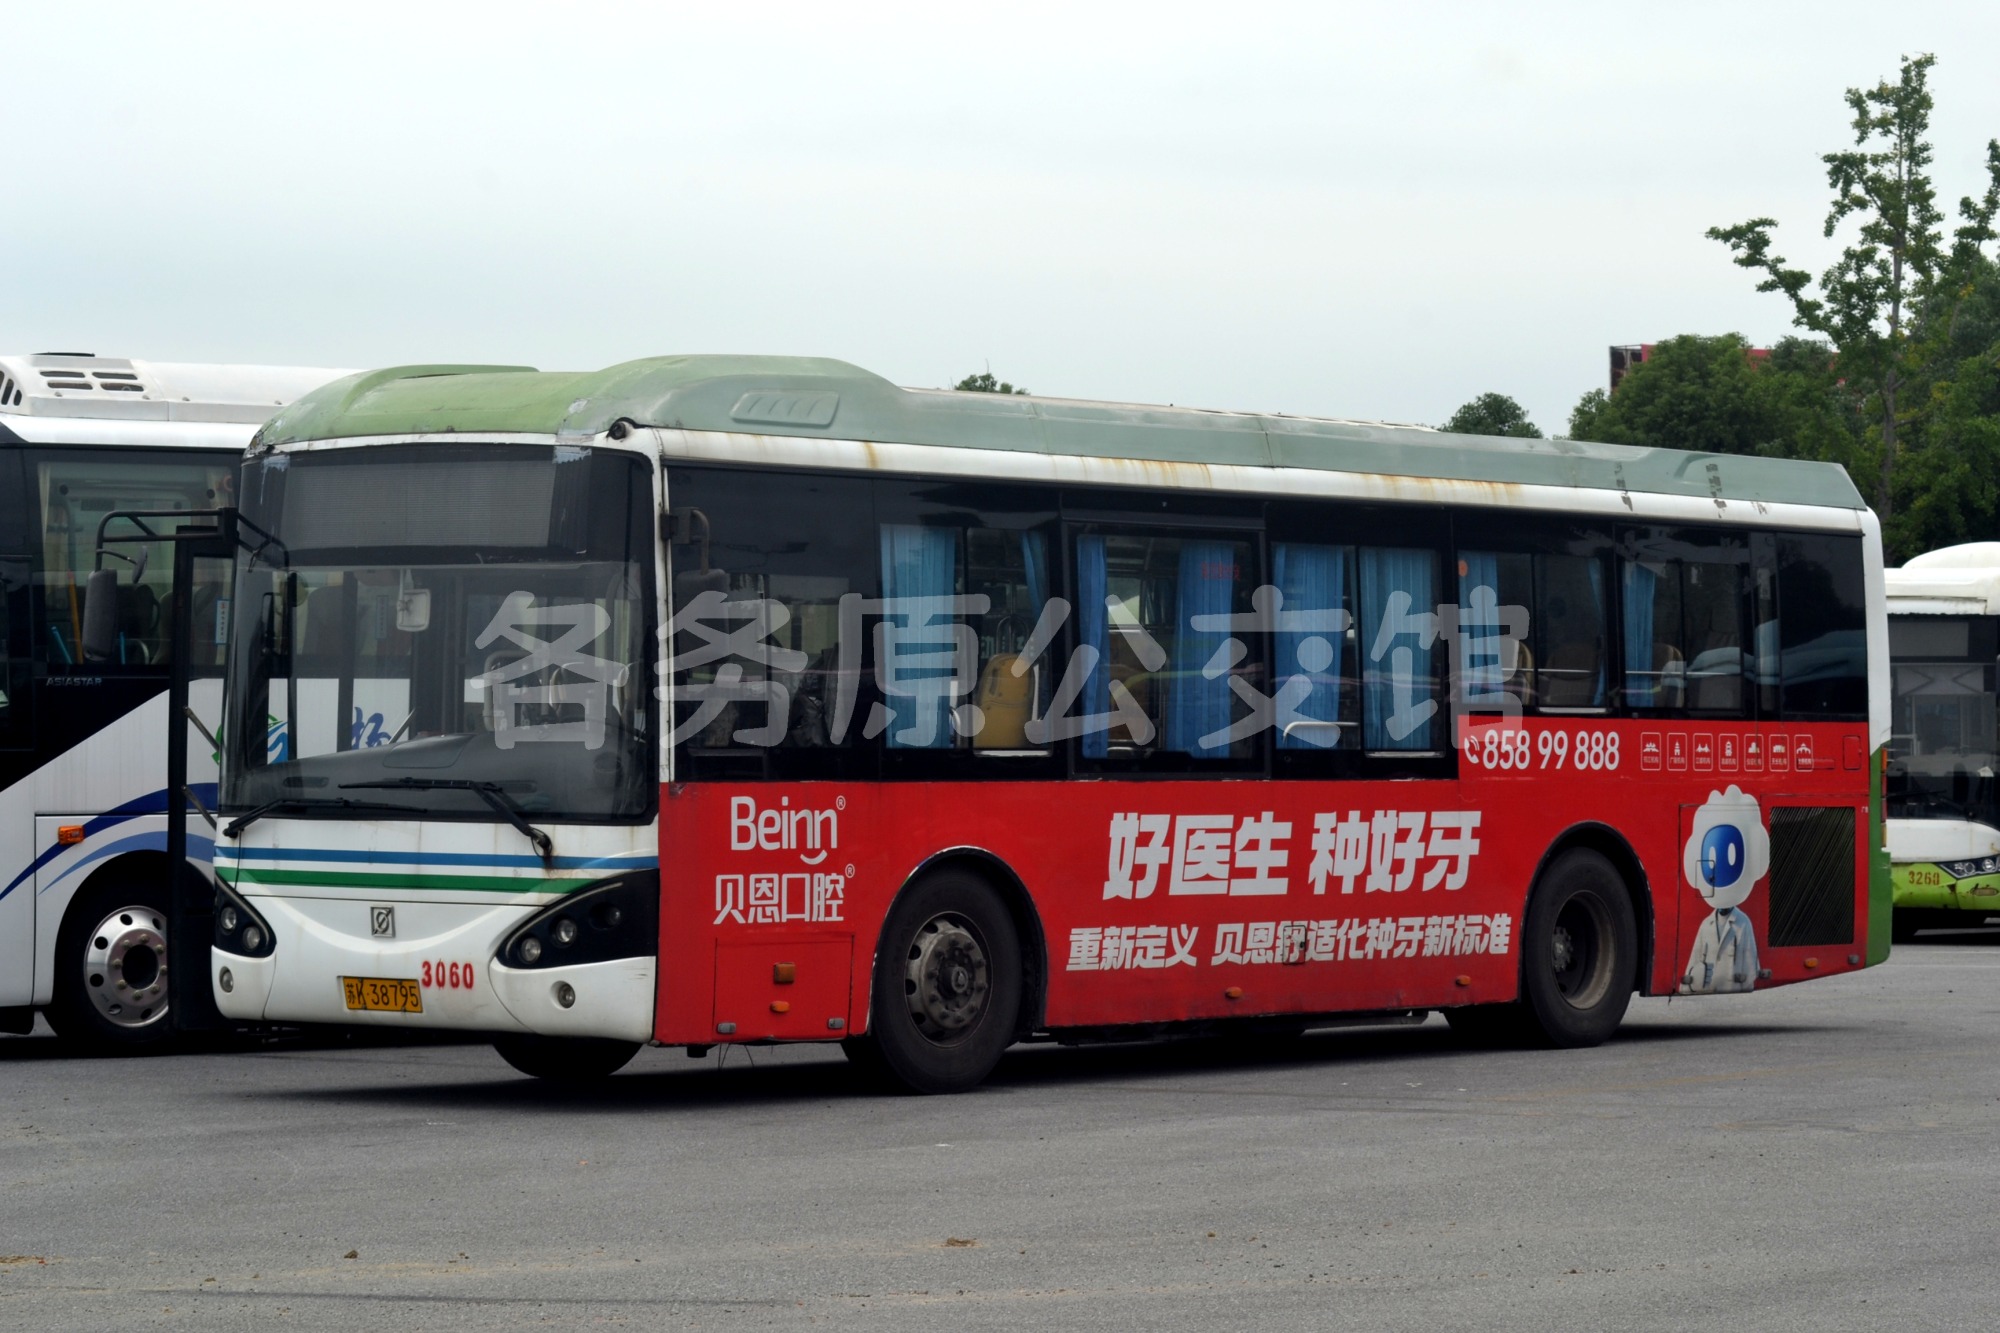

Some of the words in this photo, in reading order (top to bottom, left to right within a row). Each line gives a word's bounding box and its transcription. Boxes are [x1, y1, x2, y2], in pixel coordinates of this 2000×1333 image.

[46, 677, 102, 686] ASIASTAR
[1483, 729, 1530, 770] 858
[1538, 730, 1568, 770] 99
[1574, 731, 1620, 770] 888
[1103, 811, 1293, 900] 好医生
[1308, 810, 1482, 895] 种好牙
[1909, 870, 1940, 886] 3260
[1066, 924, 1199, 971] 重新定义
[1211, 912, 1512, 966] 贝恩舒适化种牙新标准
[422, 960, 475, 990] 3060
